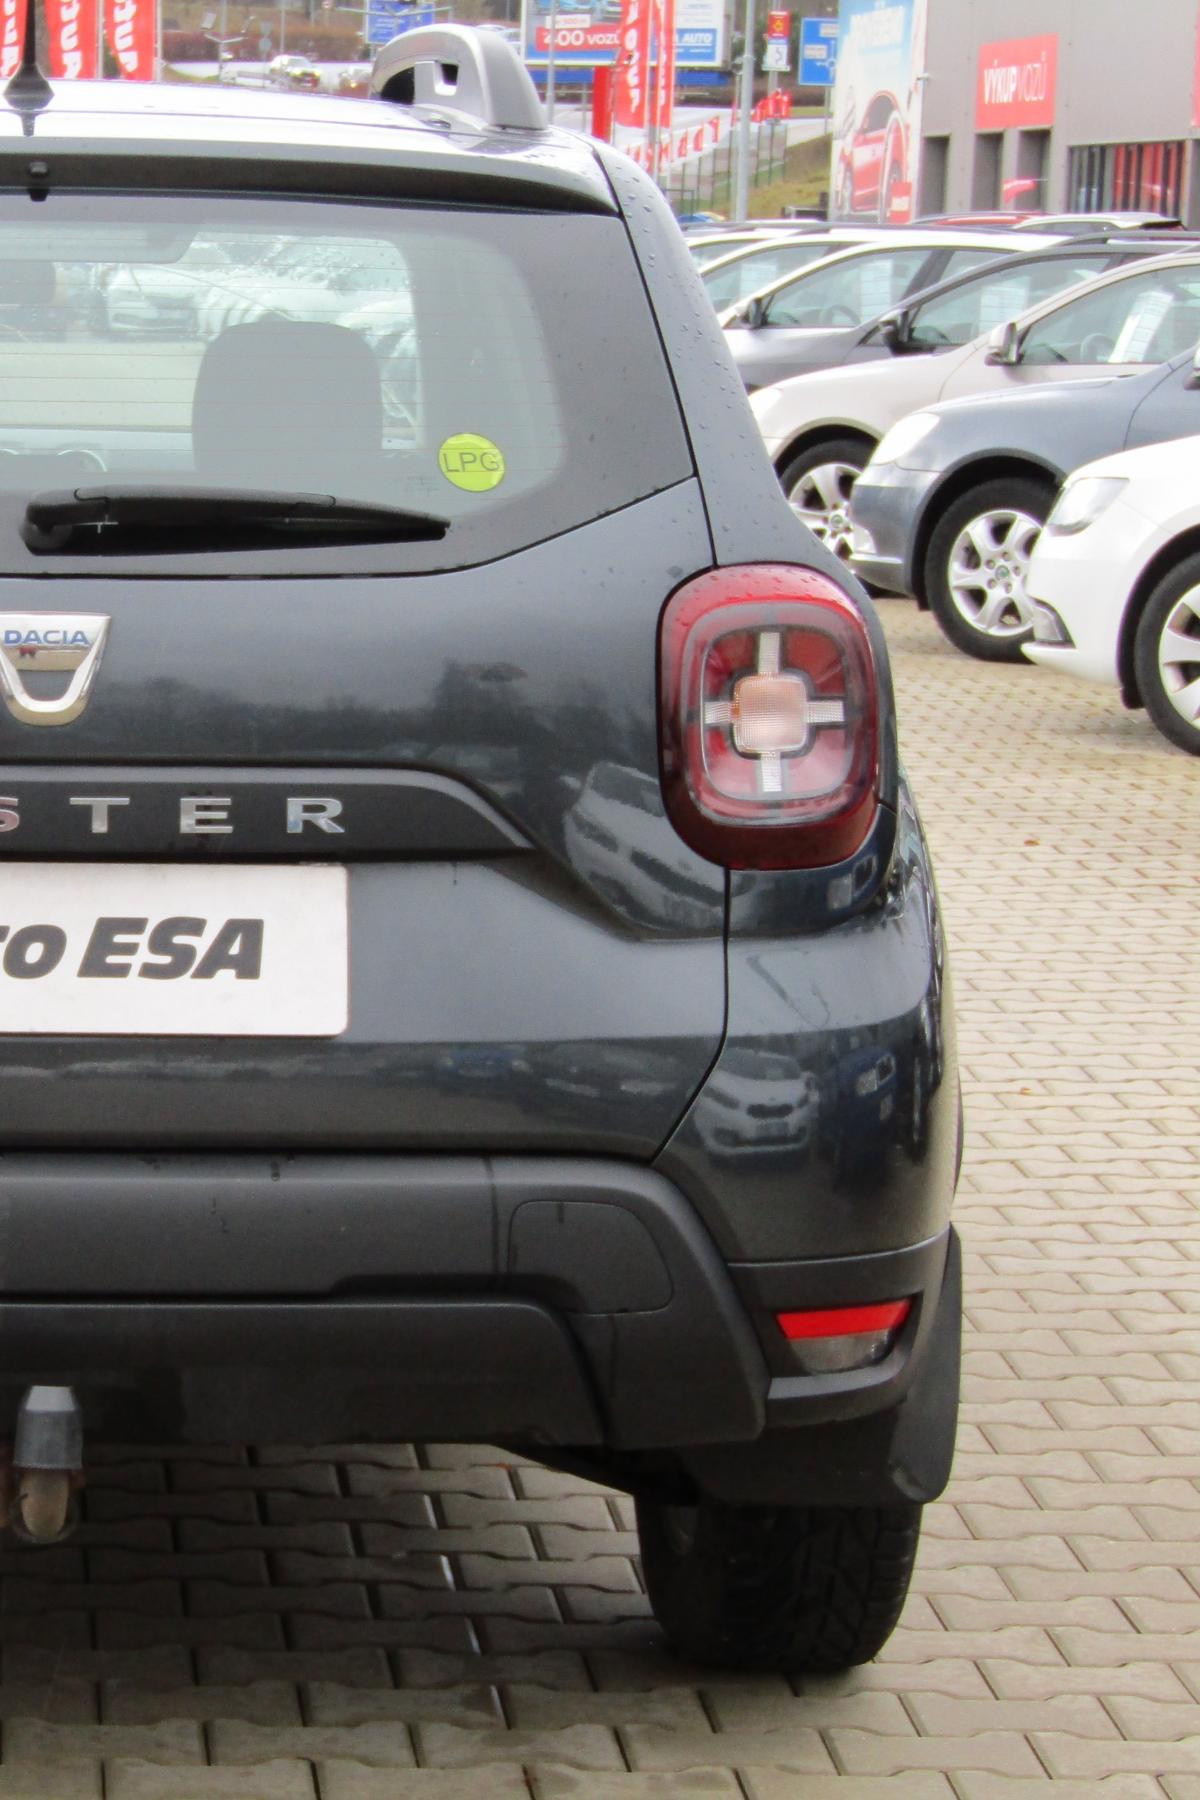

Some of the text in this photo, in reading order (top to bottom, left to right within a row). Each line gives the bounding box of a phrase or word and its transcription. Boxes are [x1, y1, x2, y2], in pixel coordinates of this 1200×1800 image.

[983, 51, 1048, 104] VÝKUP VOZŮ
[442, 451, 500, 472] LPG
[4, 629, 89, 645] DACIA
[76, 916, 265, 981] ESA
